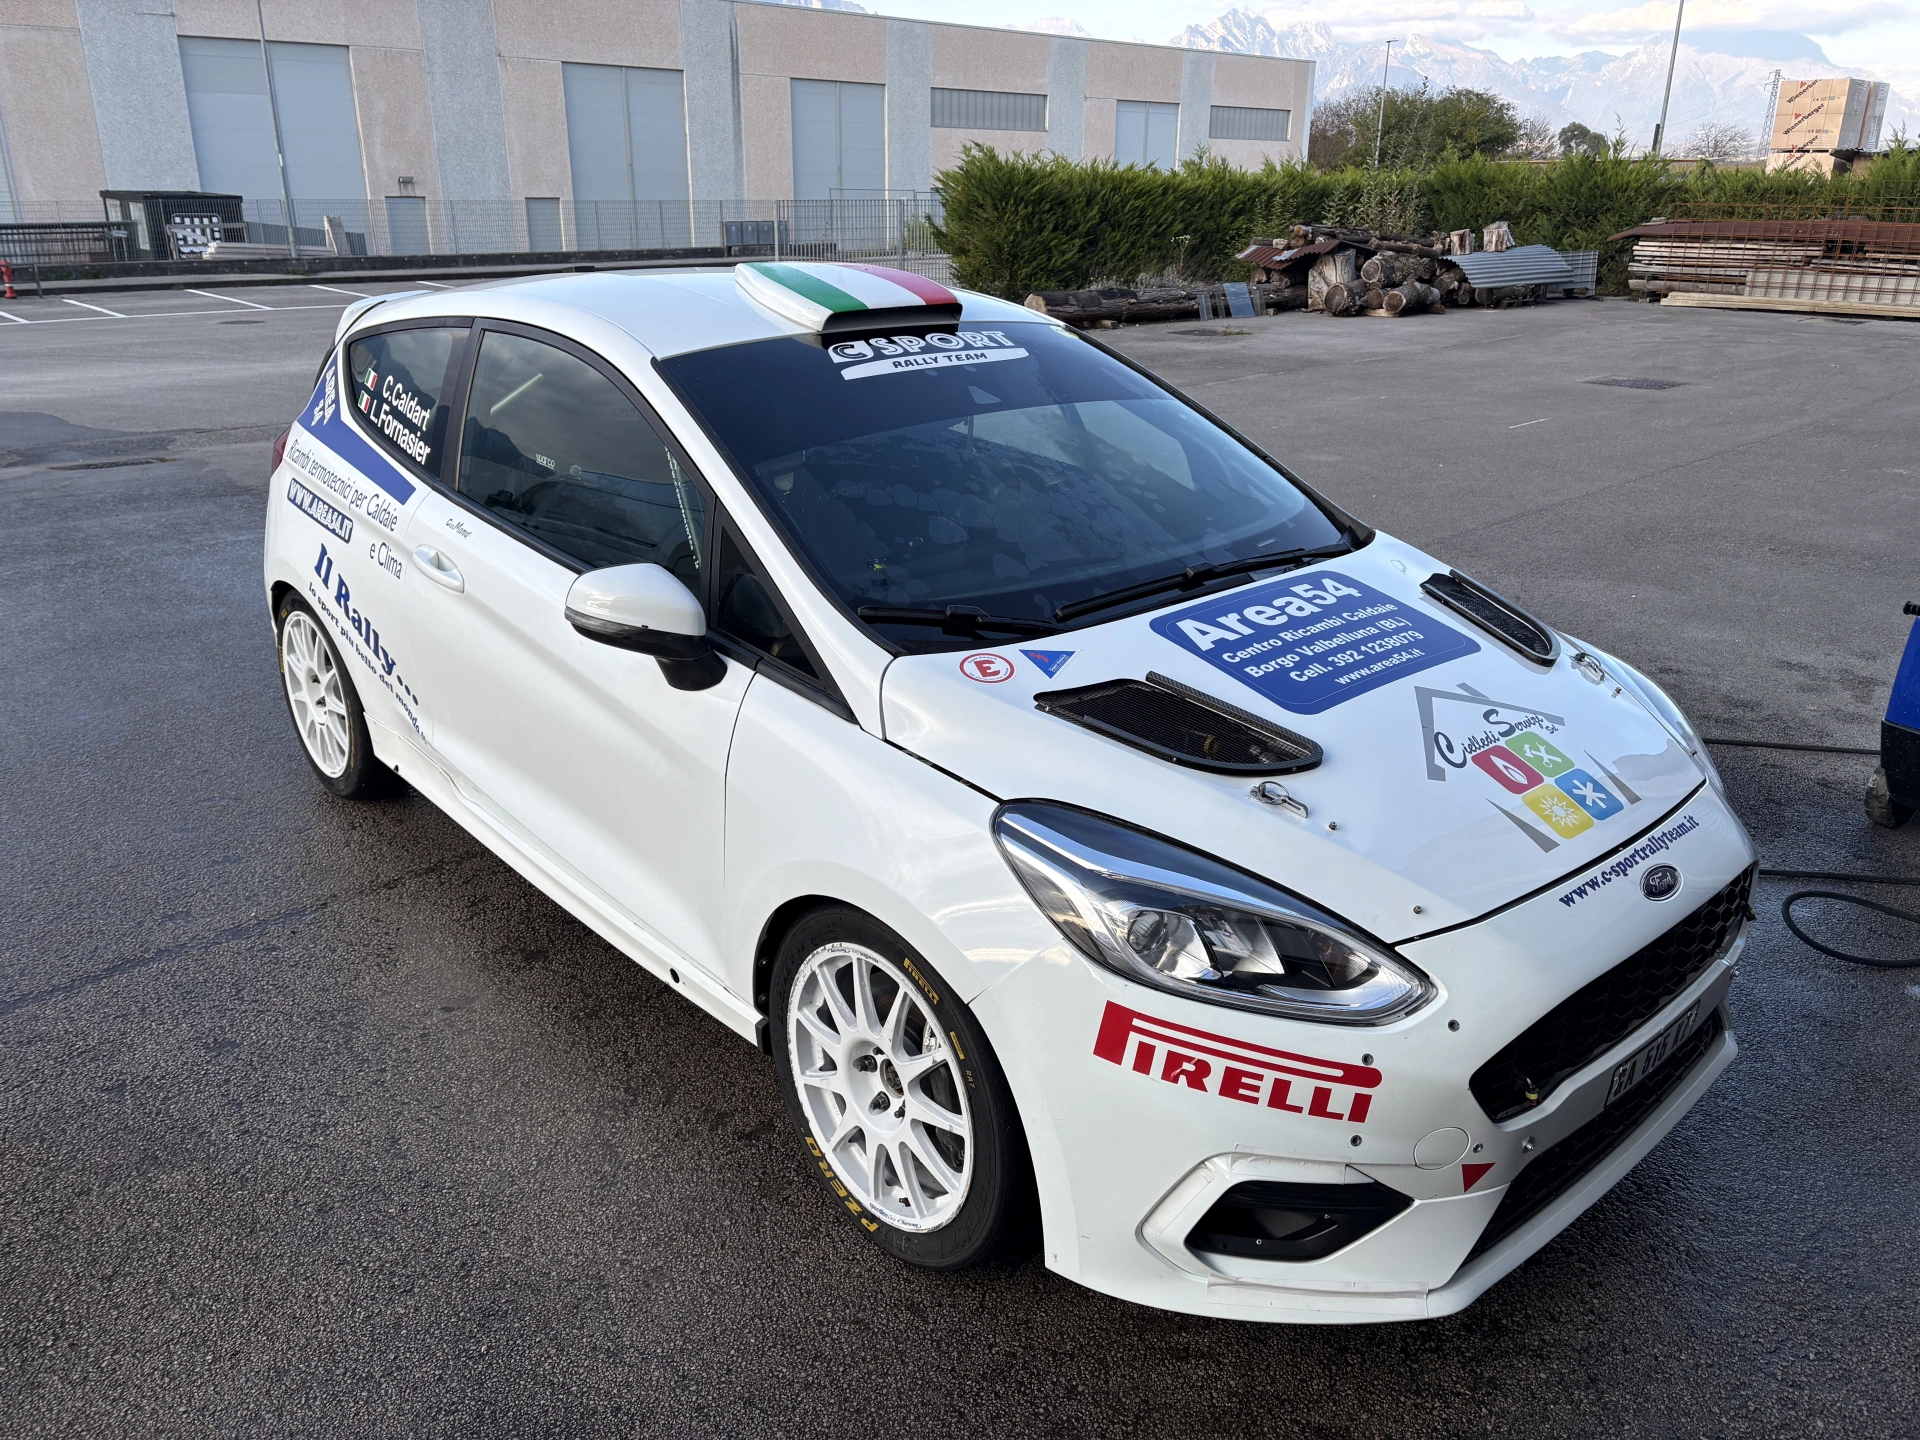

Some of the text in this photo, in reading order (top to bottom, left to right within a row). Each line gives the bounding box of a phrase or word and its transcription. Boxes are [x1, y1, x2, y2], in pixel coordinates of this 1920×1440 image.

[1785, 79, 1823, 104] Wienerber
[1782, 103, 1825, 136] Wienerberger
[892, 352, 988, 369] RALLY TEAM
[382, 374, 431, 431] C.Caldart
[369, 399, 431, 465] L.Fornasier
[286, 438, 398, 532] Ricambi termotecnici per Caldaie
[535, 453, 556, 469] sparco
[288, 480, 353, 542] WWW.AREA54.IT
[369, 541, 403, 580] e Clima
[308, 582, 316, 598] lo
[317, 596, 340, 629] sport
[355, 641, 377, 675] bello
[379, 673, 394, 694] del
[314, 543, 419, 706] Il Rally...
[1175, 577, 1363, 652] Area54
[1222, 602, 1399, 664] Centro Ricambi Caldaie
[973, 659, 1001, 678] E
[1244, 616, 1413, 679] Borgo Valbelluna (BL)
[1289, 630, 1424, 684] Cell. 392 1238079
[1334, 647, 1426, 686] www.area54.it
[1433, 731, 1500, 769] Cielledi
[1482, 708, 1544, 738] Servizi
[1558, 814, 1701, 908] www.c-sportrallyteam.it
[1649, 871, 1674, 893] Ford
[903, 957, 939, 1006] PIRELLI
[965, 1069, 976, 1089] RA7
[1093, 999, 1383, 1124] PIRELLI
[1641, 1032, 1671, 1075] 515
